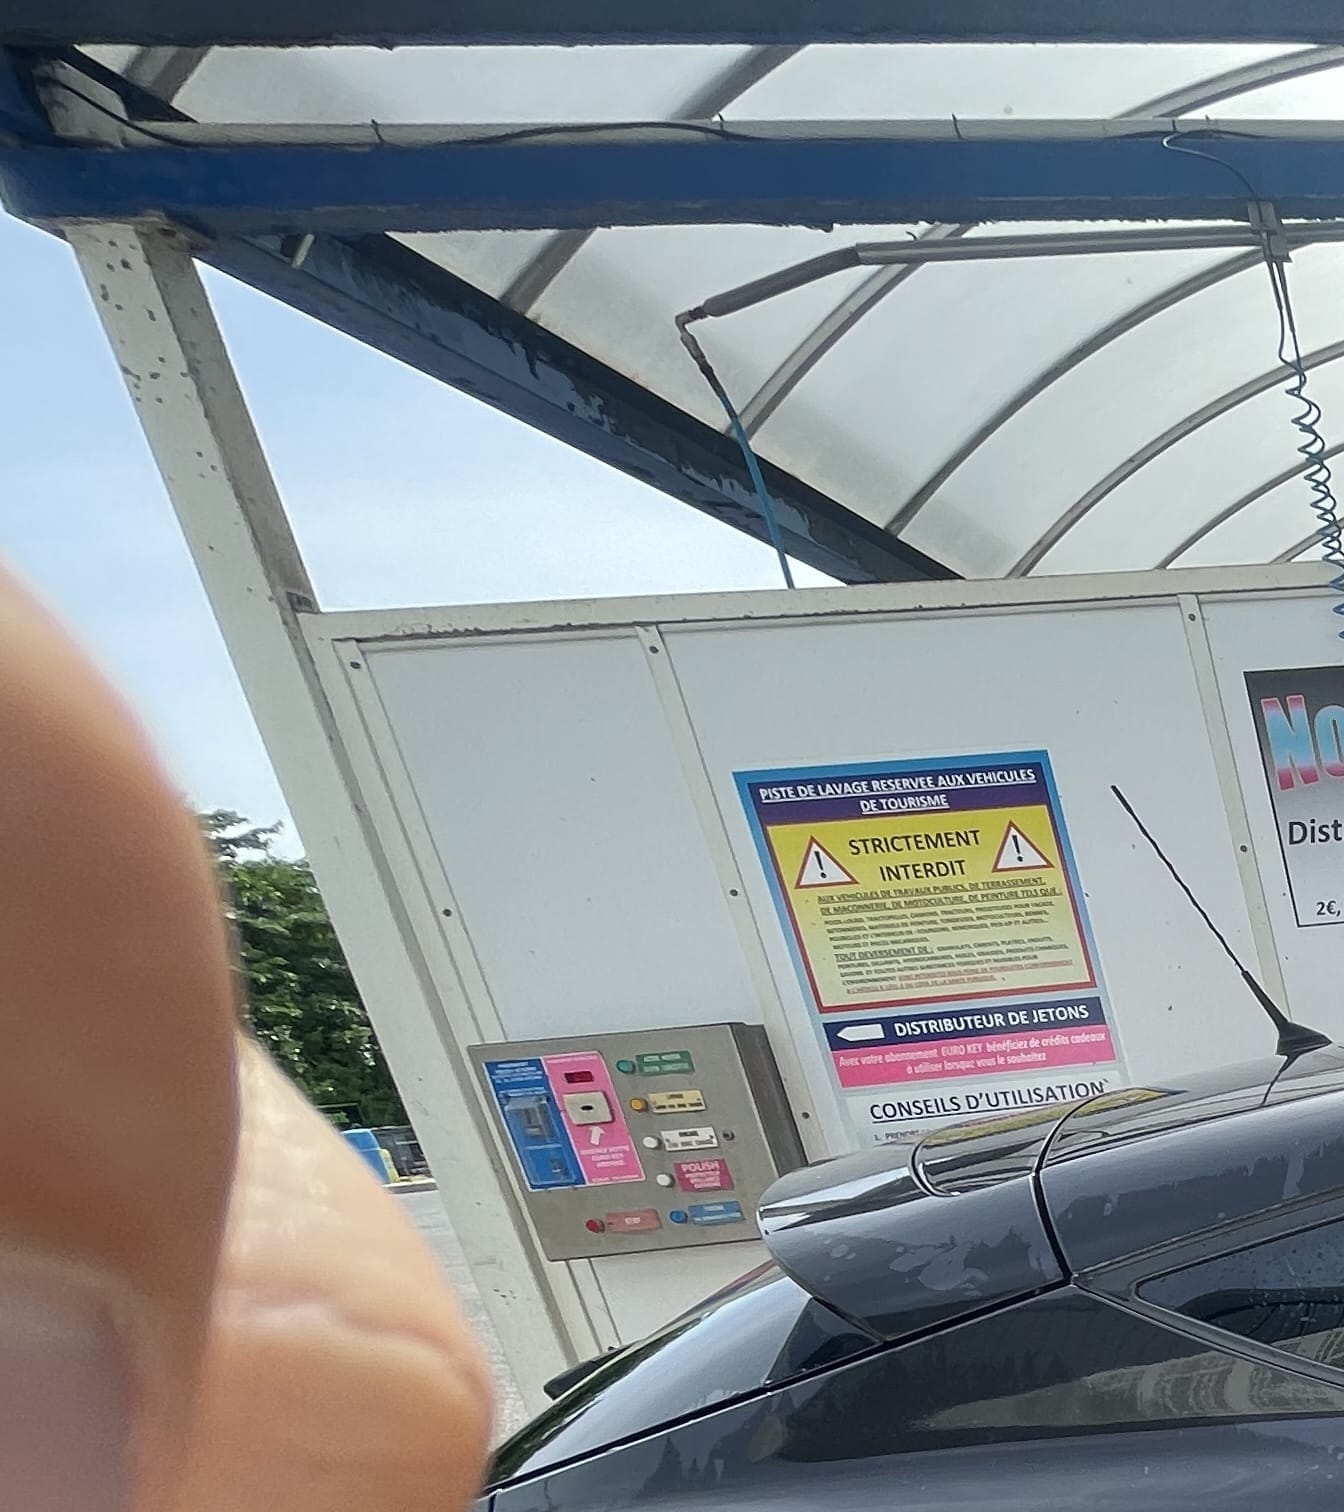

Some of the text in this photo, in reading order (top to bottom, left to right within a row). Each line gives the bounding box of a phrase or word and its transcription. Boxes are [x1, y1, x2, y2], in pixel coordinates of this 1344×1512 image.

[760, 769, 1036, 801] PISTE DE LAVAGE RESERVEE AUX VEHICULES
[860, 794, 948, 812] DE TOURISME
[849, 830, 980, 855] STRICTEMENT
[880, 860, 966, 881] INTERDIT
[1316, 901, 1341, 916] 2€,
[894, 1007, 1089, 1037] DISTRIBUTEUR DE JETONS
[840, 1057, 860, 1067] Avec
[861, 1054, 883, 1064] votre
[885, 1049, 938, 1063] abonnement
[941, 1045, 965, 1057] EURO
[966, 1043, 983, 1054] KEY
[1029, 1038, 1040, 1048] de
[1041, 1033, 1070, 1046] crédits
[1071, 1032, 1106, 1044] cadeaux
[914, 1062, 942, 1073] utiliser
[944, 1059, 975, 1072] lorsque
[977, 1057, 996, 1067] vous
[997, 1055, 1005, 1065] le
[1007, 1052, 1047, 1063] souhaitez
[870, 1098, 961, 1120] CONSEILS
[681, 1161, 720, 1172] POLISH
